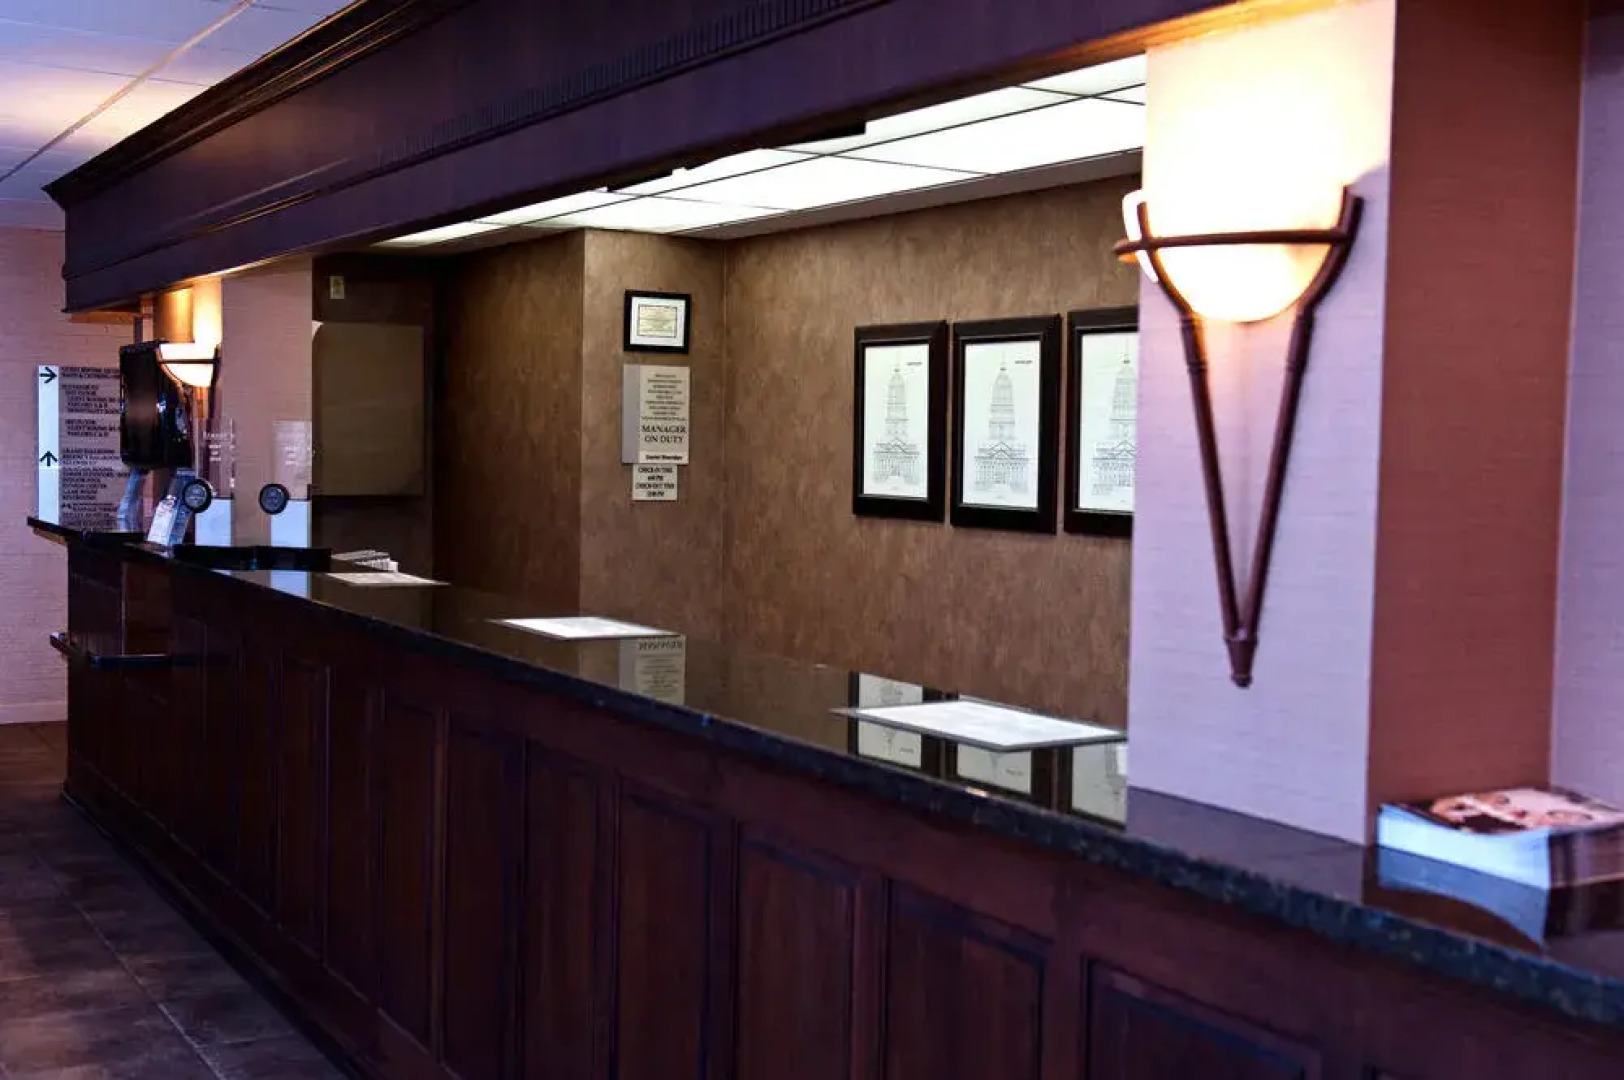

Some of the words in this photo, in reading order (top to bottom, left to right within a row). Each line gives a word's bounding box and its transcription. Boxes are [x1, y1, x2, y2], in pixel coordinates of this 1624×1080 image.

[642, 425, 687, 433] MANAGER
[644, 435, 658, 443] ON
[660, 435, 683, 443] DUTY
